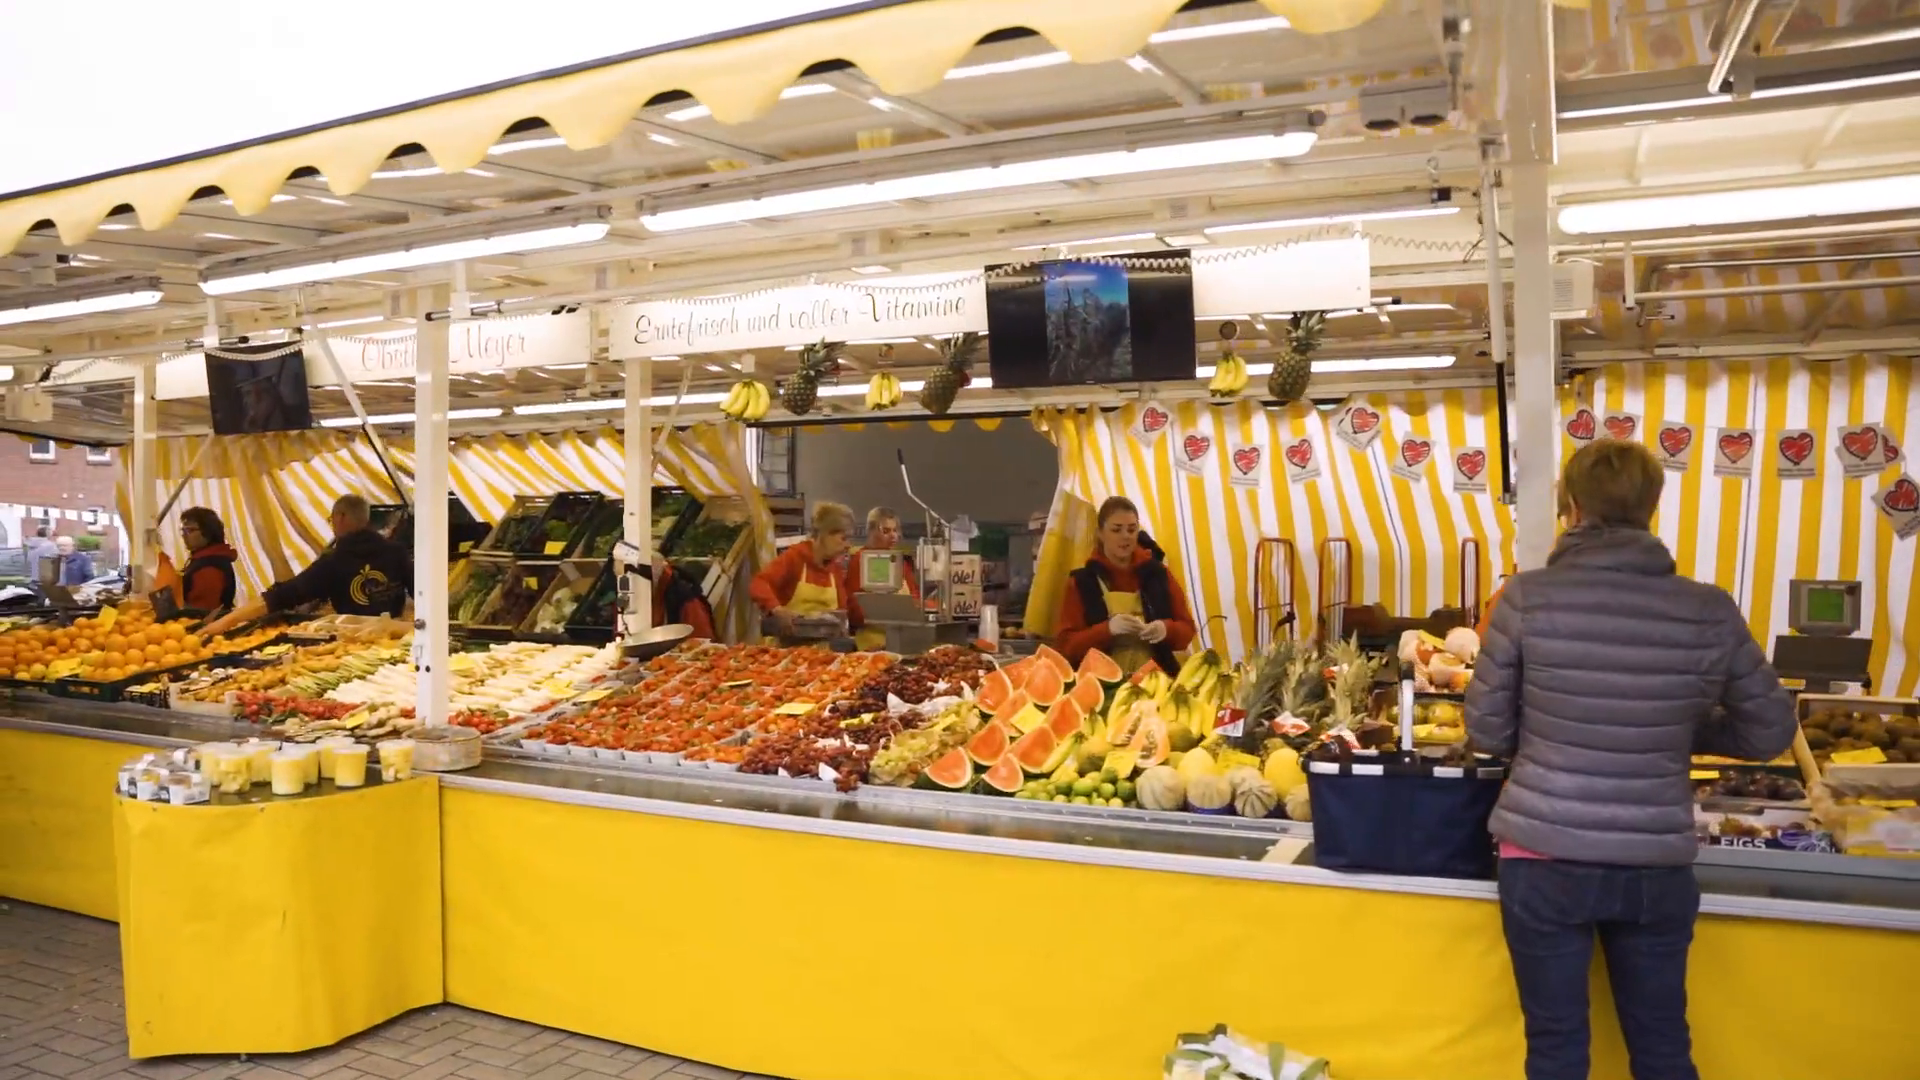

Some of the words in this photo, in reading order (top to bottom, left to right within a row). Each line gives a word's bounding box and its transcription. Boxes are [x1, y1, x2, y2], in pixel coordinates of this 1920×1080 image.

[633, 307, 739, 346] Erntefrisch
[747, 303, 781, 331] und
[789, 298, 850, 329] voller
[859, 292, 966, 322] Vitamine
